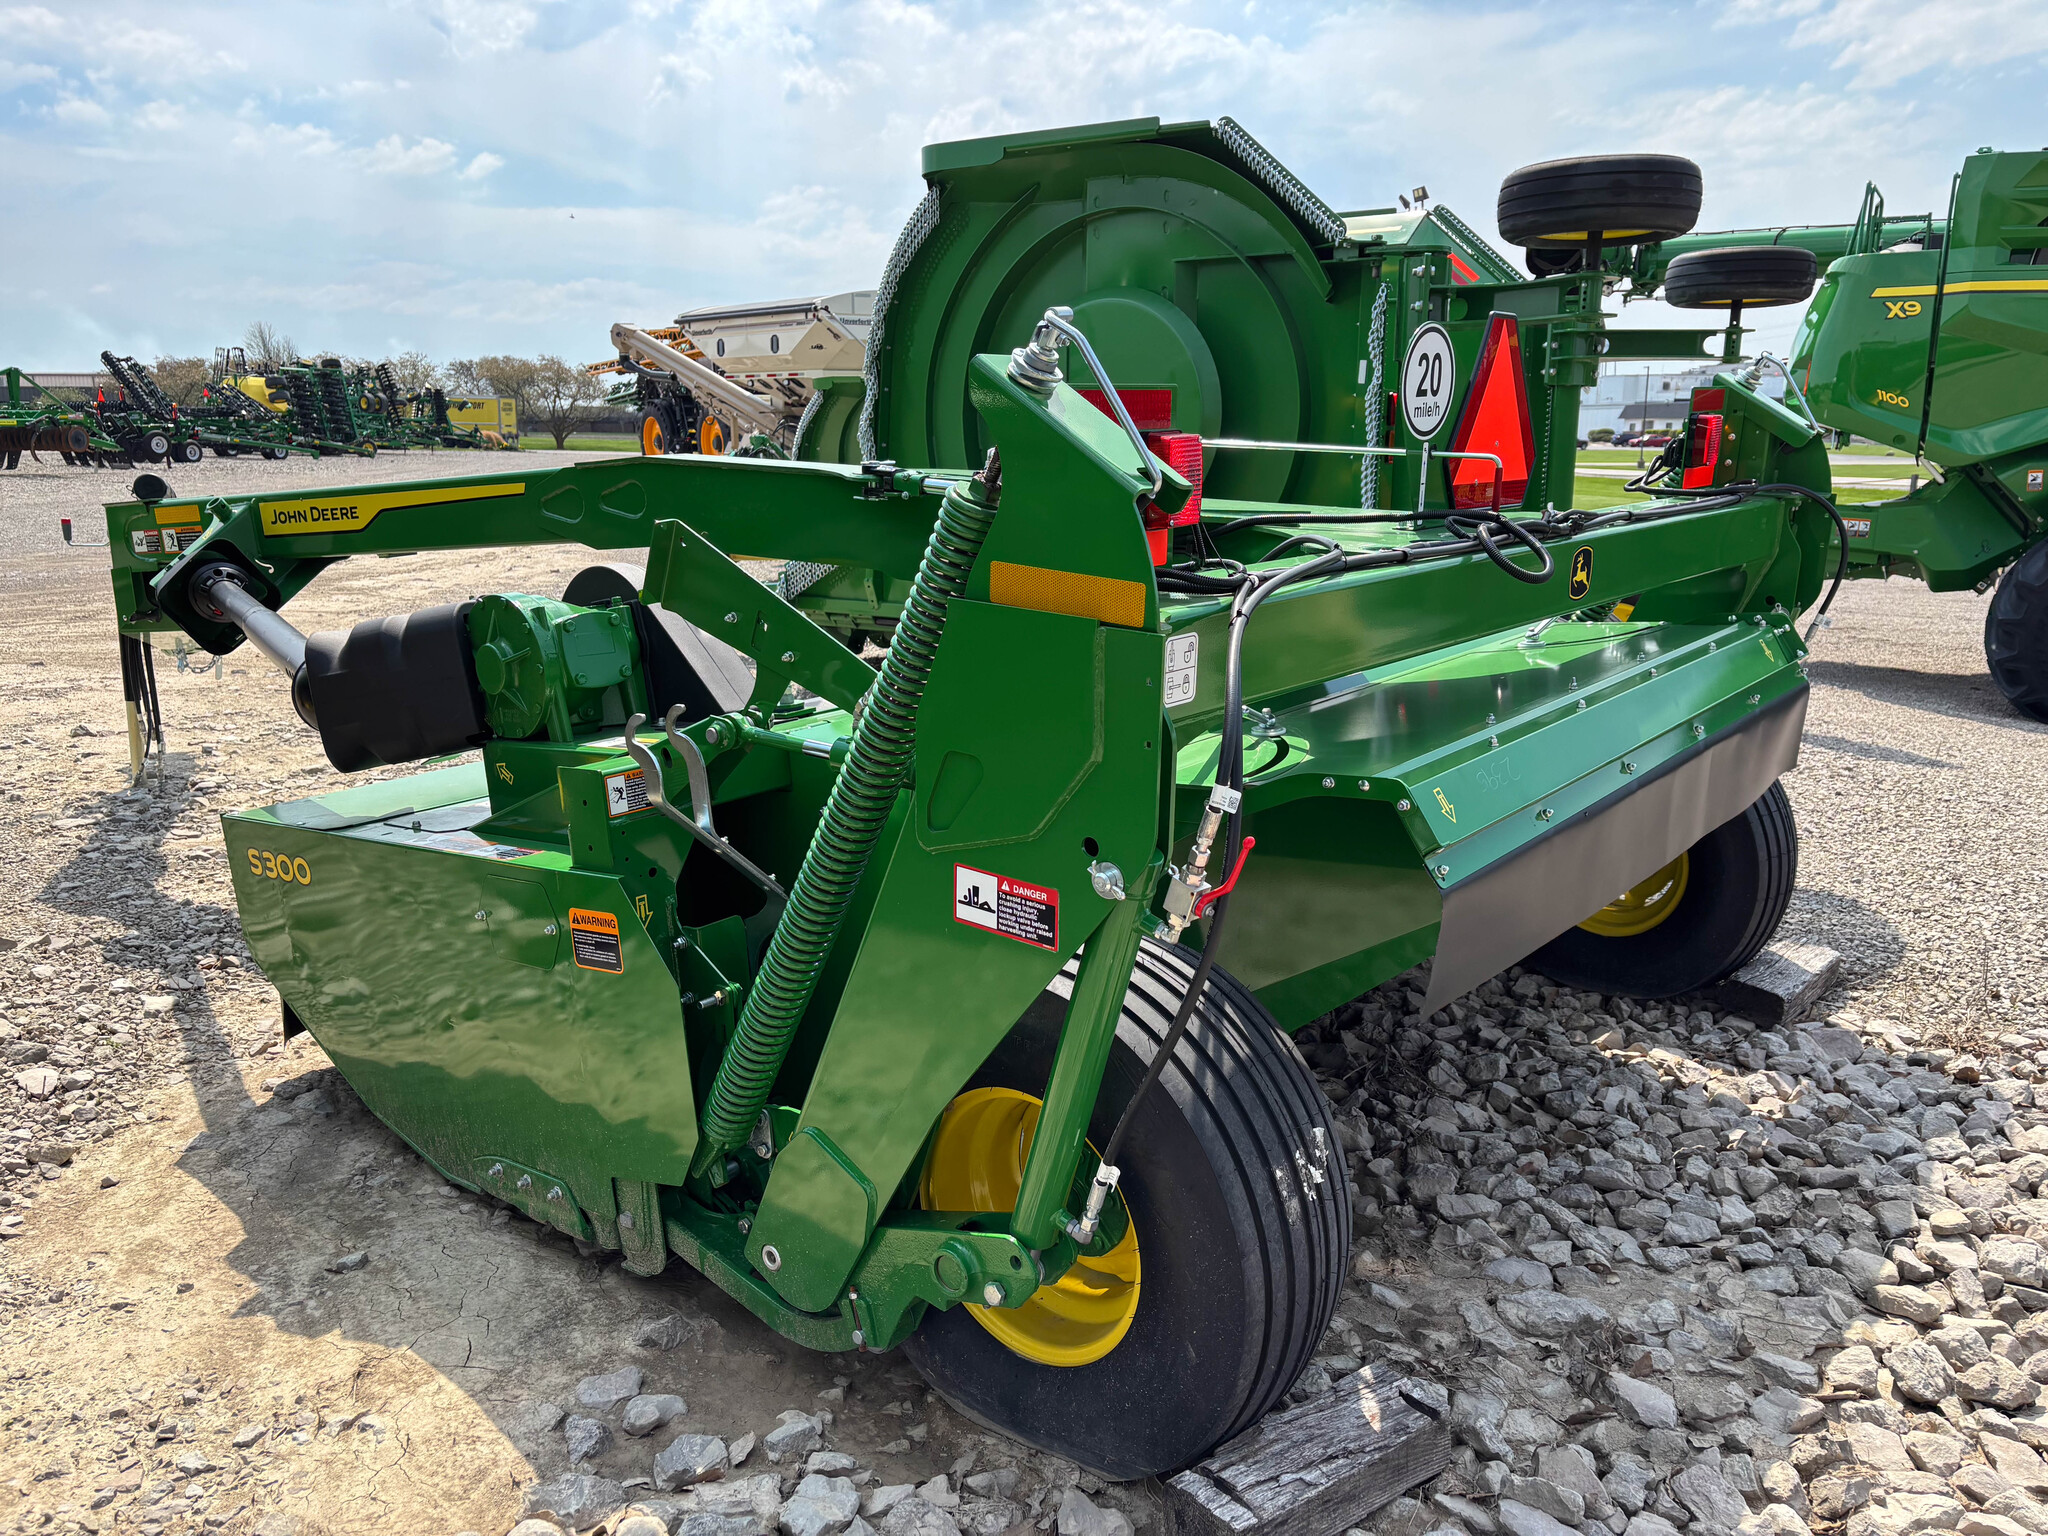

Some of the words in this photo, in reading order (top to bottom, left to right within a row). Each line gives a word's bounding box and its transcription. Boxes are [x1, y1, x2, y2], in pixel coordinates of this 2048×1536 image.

[1883, 300, 1922, 320] X9
[1415, 352, 1443, 398] 20
[1876, 389, 1910, 408] 1100
[1413, 401, 1441, 418] mile/h
[271, 509, 308, 525] JOHN
[309, 506, 360, 522] DEERE
[247, 846, 312, 886] S300
[999, 891, 1006, 899] To
[1006, 894, 1021, 903] avoid
[1026, 900, 1046, 910] serious
[1013, 885, 1048, 901] DANGER
[999, 899, 1022, 911] crushing
[579, 914, 616, 929] WARNING
[999, 911, 1016, 921] lockup
[1017, 916, 1031, 925] valve
[1031, 920, 1049, 930] before
[1013, 909, 1038, 921] hydraulic
[999, 918, 1020, 930] working
[1020, 924, 1036, 933] under
[1036, 928, 1053, 938] raised
[999, 923, 1026, 938] harvesting
